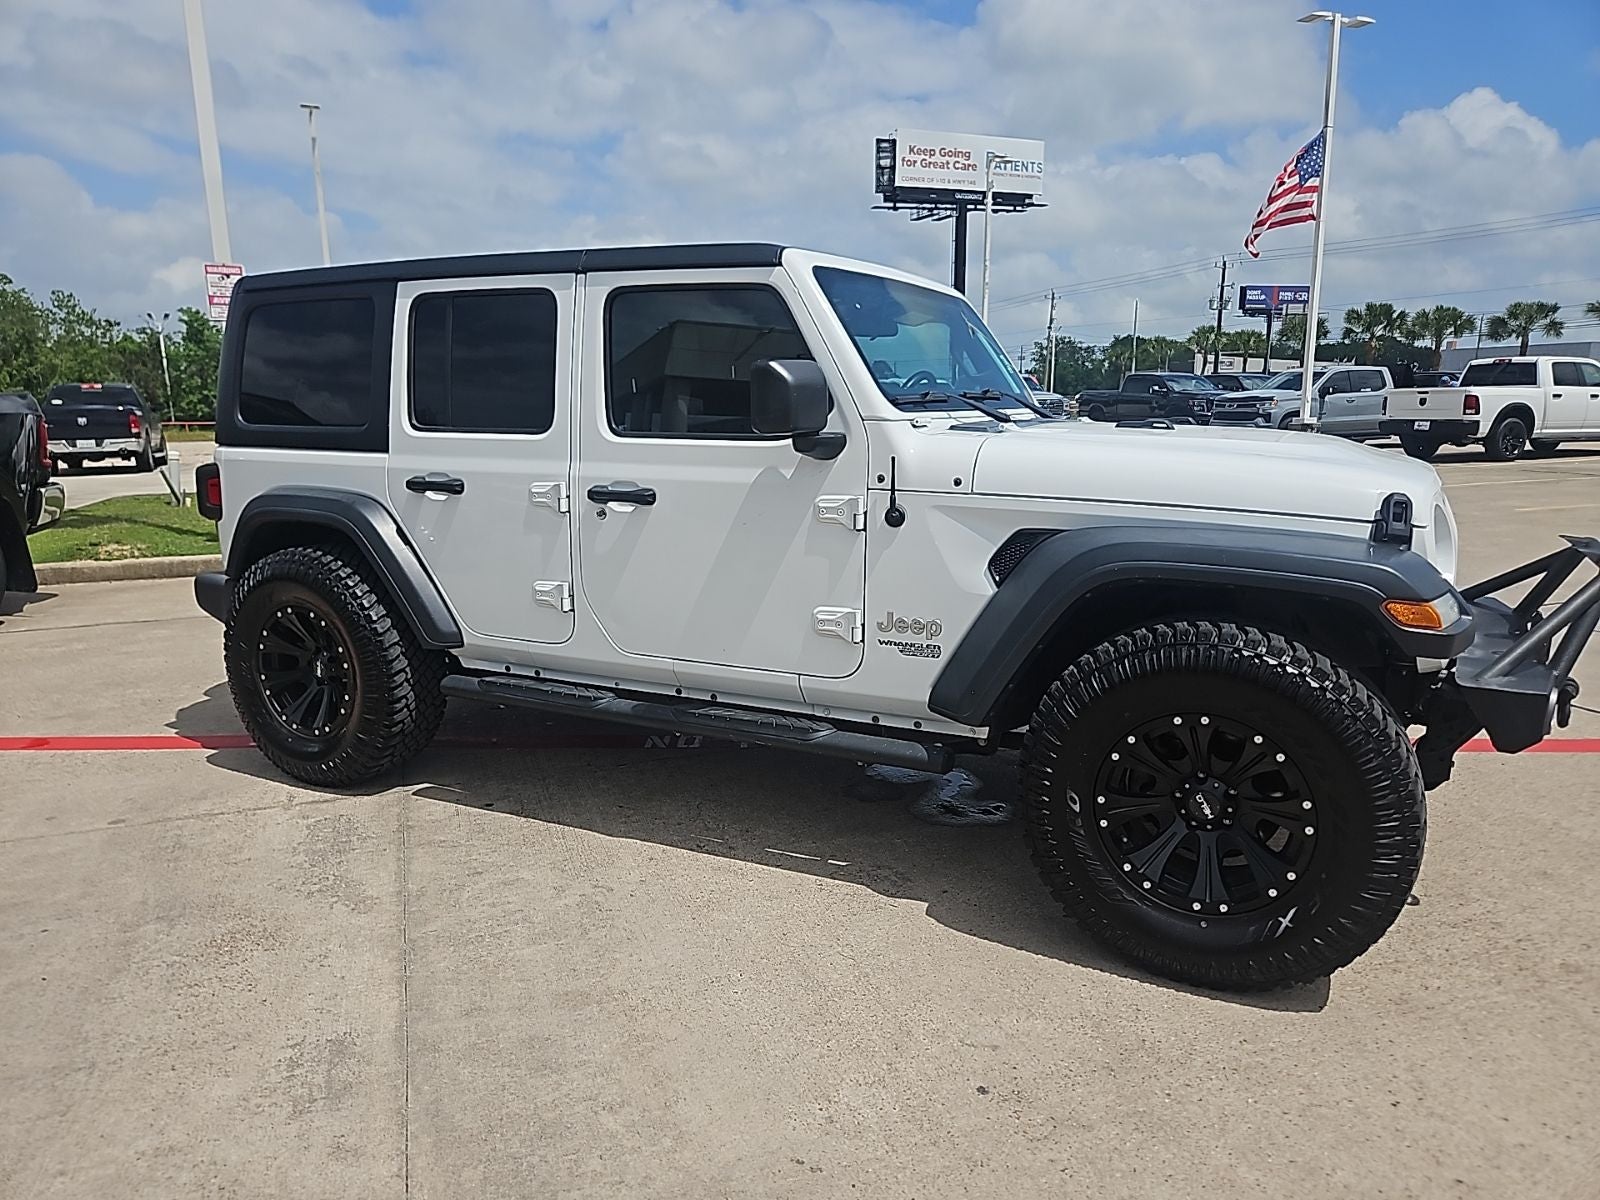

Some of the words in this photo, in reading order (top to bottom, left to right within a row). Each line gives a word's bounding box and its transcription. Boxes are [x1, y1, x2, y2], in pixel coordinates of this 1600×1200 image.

[908, 145, 935, 158] Keep
[938, 147, 971, 161] Going
[901, 157, 918, 168] for
[920, 158, 951, 171] Great
[953, 161, 978, 172] Care
[901, 175, 926, 183] CORNER
[877, 611, 942, 640] Jeep
[877, 639, 942, 650] WRANGLER
